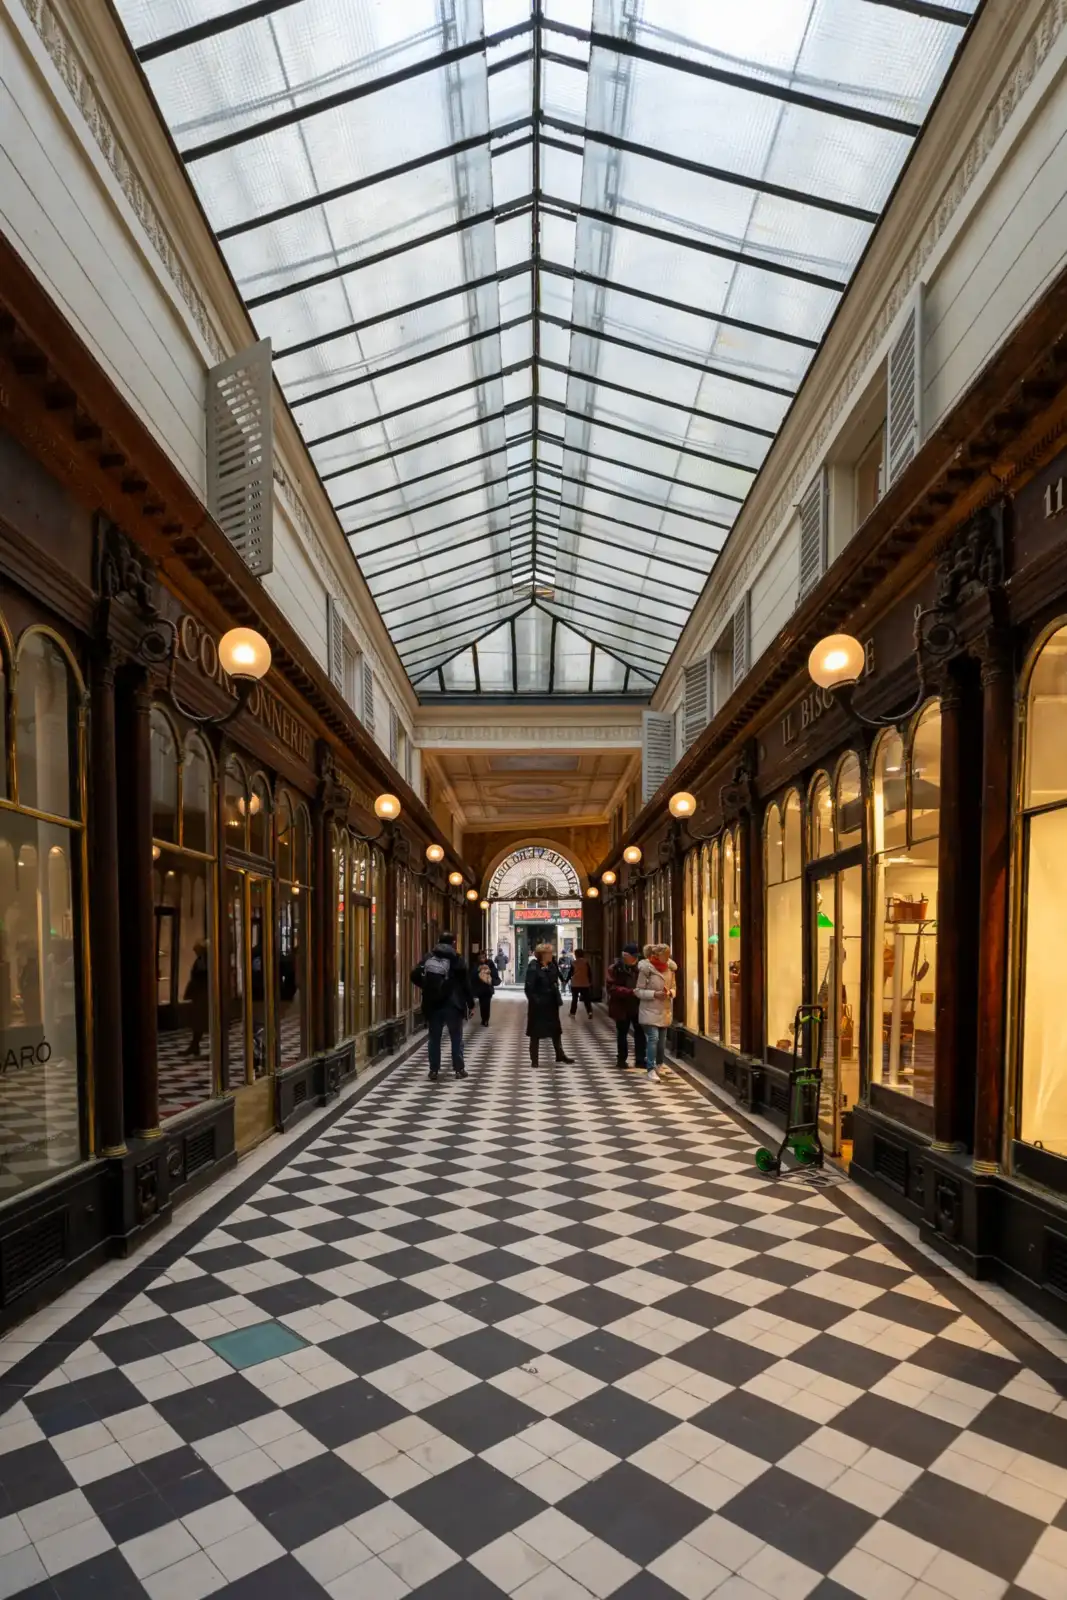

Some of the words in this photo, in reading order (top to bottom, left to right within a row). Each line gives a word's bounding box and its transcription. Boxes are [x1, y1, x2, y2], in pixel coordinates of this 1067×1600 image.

[1043, 476, 1064, 519] 11
[781, 713, 794, 746] IL
[514, 909, 551, 920] PIZZA
[0, 1035, 52, 1073] ARÓ
